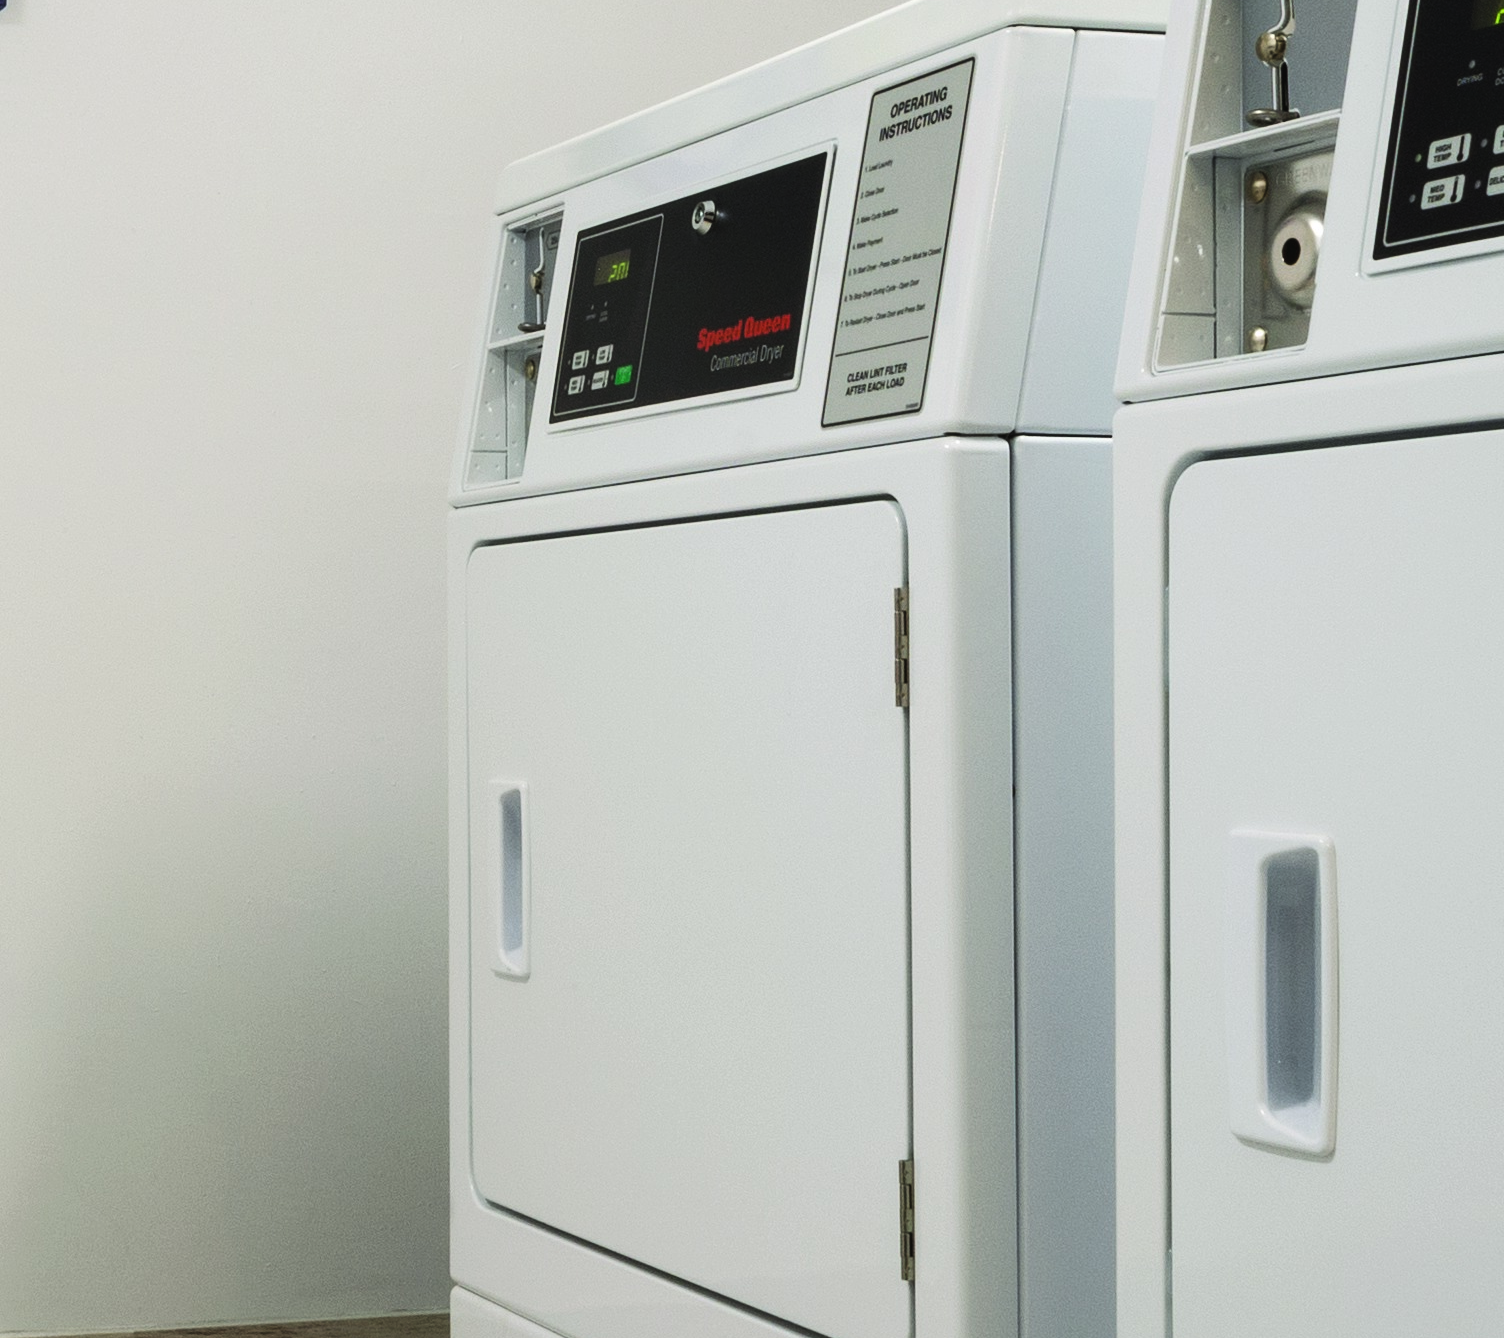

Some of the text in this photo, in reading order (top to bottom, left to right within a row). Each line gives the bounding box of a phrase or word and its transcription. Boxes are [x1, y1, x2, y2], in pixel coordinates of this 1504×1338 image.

[1456, 72, 1483, 86] DRYING
[889, 86, 948, 118] OPERATING
[878, 104, 952, 141] INSTRUCTIONS
[1433, 152, 1451, 162] TEMP
[1435, 143, 1451, 153] HIGH
[1427, 192, 1445, 203] TEMP
[1429, 183, 1444, 193] MED
[696, 313, 790, 352] Speed Queen
[710, 344, 784, 371] Commercial Dryer
[846, 362, 907, 383] CLEAN LINT FILTER
[845, 376, 904, 396] AFTER EACH LOAD
